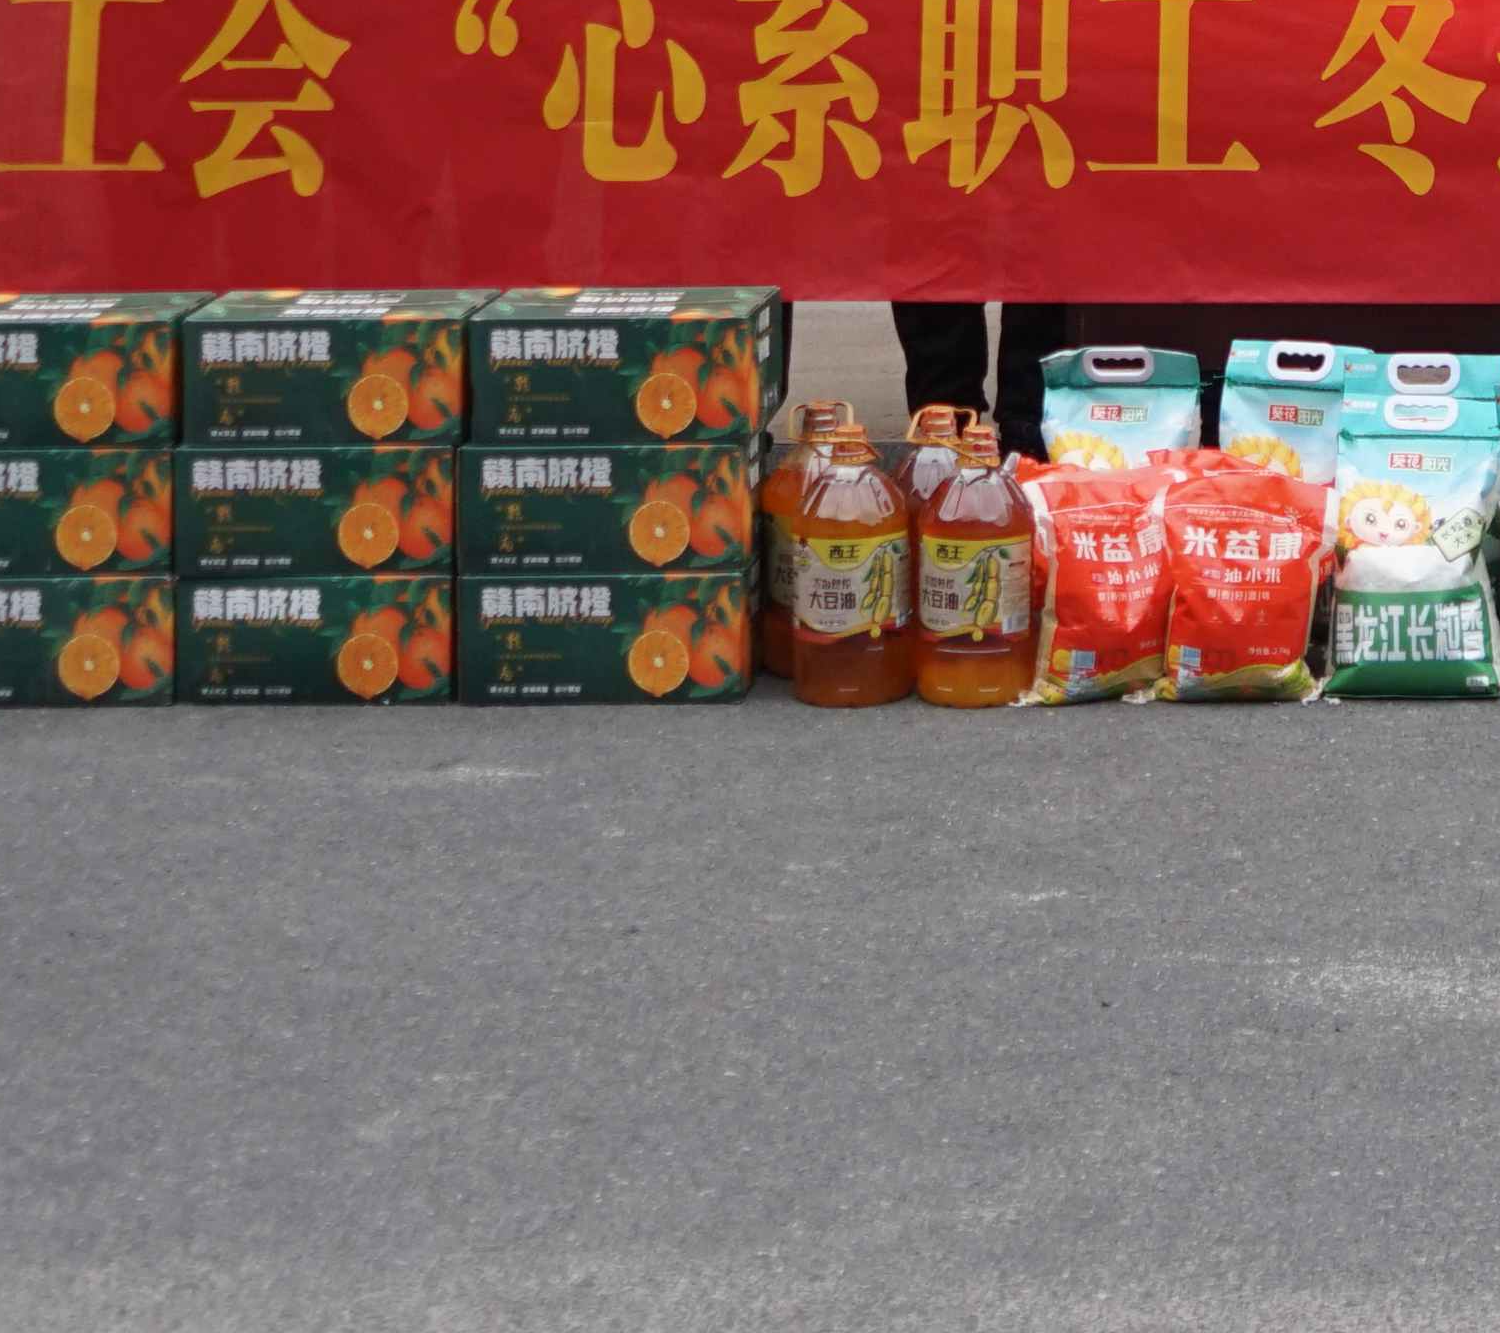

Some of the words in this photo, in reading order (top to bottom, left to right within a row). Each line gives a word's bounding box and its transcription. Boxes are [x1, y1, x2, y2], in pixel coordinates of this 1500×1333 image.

[1183, 525, 1303, 561] 米益康
[809, 590, 857, 611] 大豆油
[1336, 597, 1486, 665] 黑龙江长粒香
